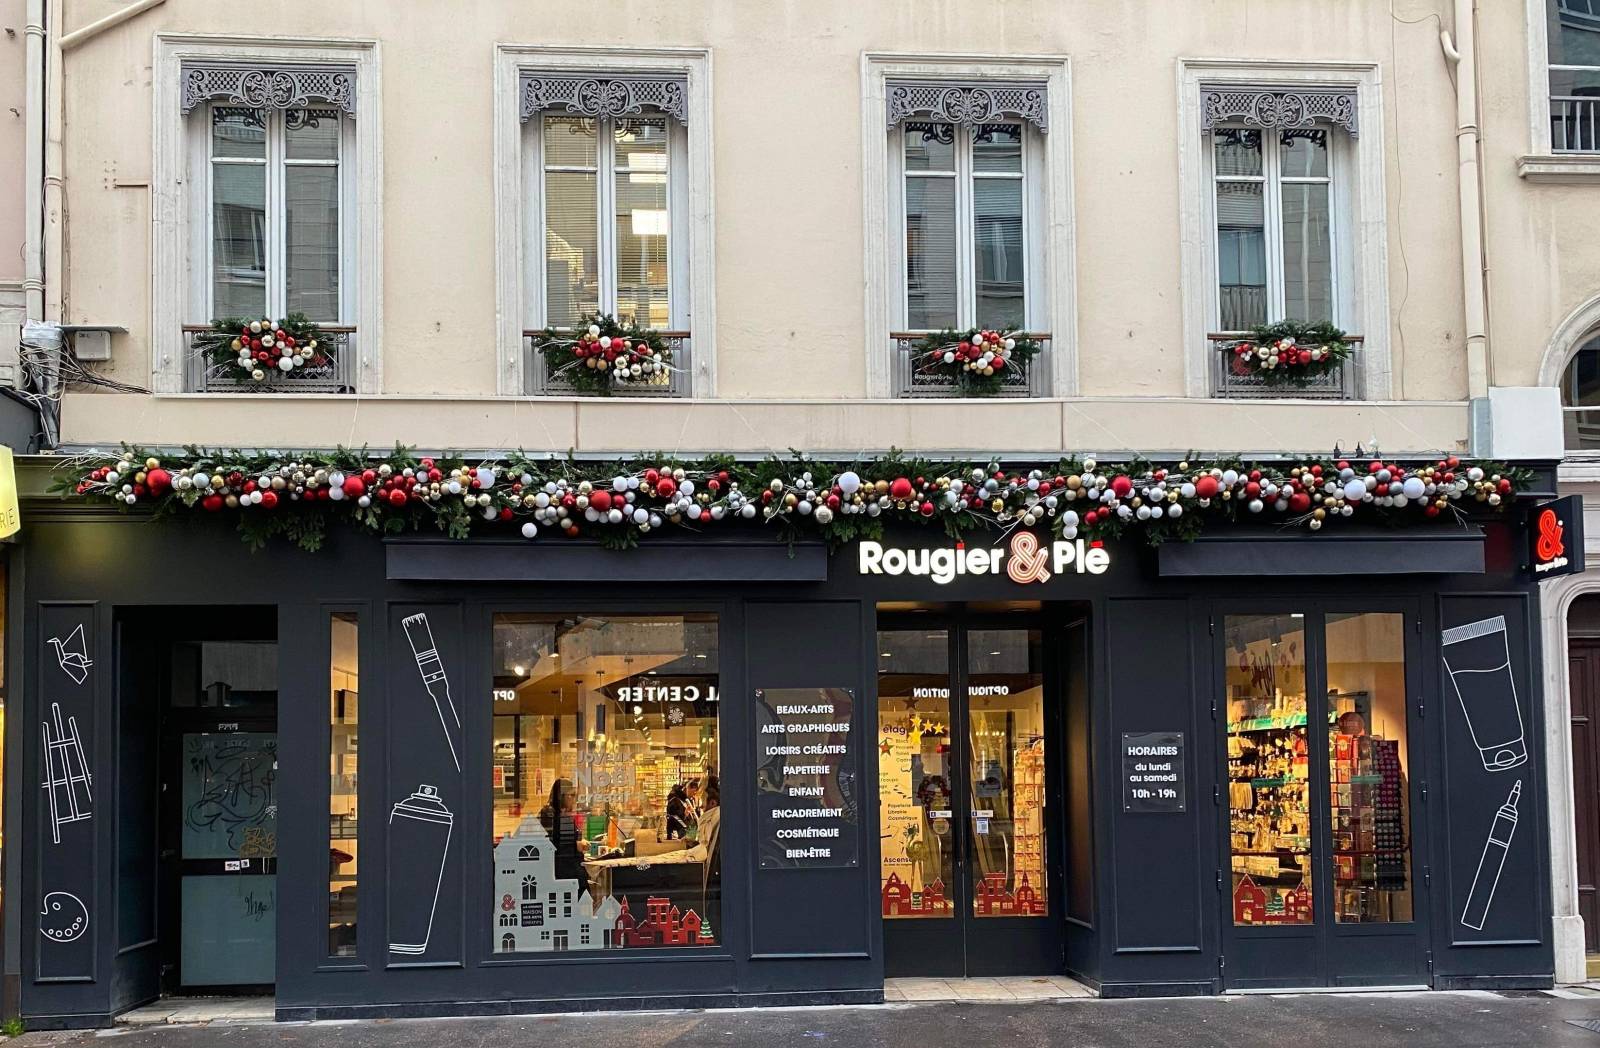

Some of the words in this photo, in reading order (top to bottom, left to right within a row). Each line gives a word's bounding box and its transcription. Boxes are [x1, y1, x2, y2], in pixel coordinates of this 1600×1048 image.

[859, 540, 1004, 585] Rougier
[1007, 531, 1051, 584] &
[1053, 538, 1110, 575] Plé
[776, 705, 834, 715] BEAUX-ARTS
[761, 724, 785, 734] ARTS
[787, 723, 850, 733] GRAPHIQUES
[765, 746, 801, 756] LOISIRS
[803, 743, 846, 755] CRÉATIFS
[1127, 746, 1178, 756] HORAIRES
[783, 765, 830, 775] PAPETERIE
[1135, 763, 1147, 771] du
[1148, 762, 1171, 771] lundi
[1143, 773, 1177, 782] samedi
[789, 787, 825, 797] ENFANT
[1131, 788, 1150, 798] 10h
[1157, 788, 1177, 798] 19h
[772, 808, 843, 819] ENCADREMENT
[776, 826, 839, 839] COSMÉTIQUE
[786, 847, 831, 859] BIEN-ÊTRE
